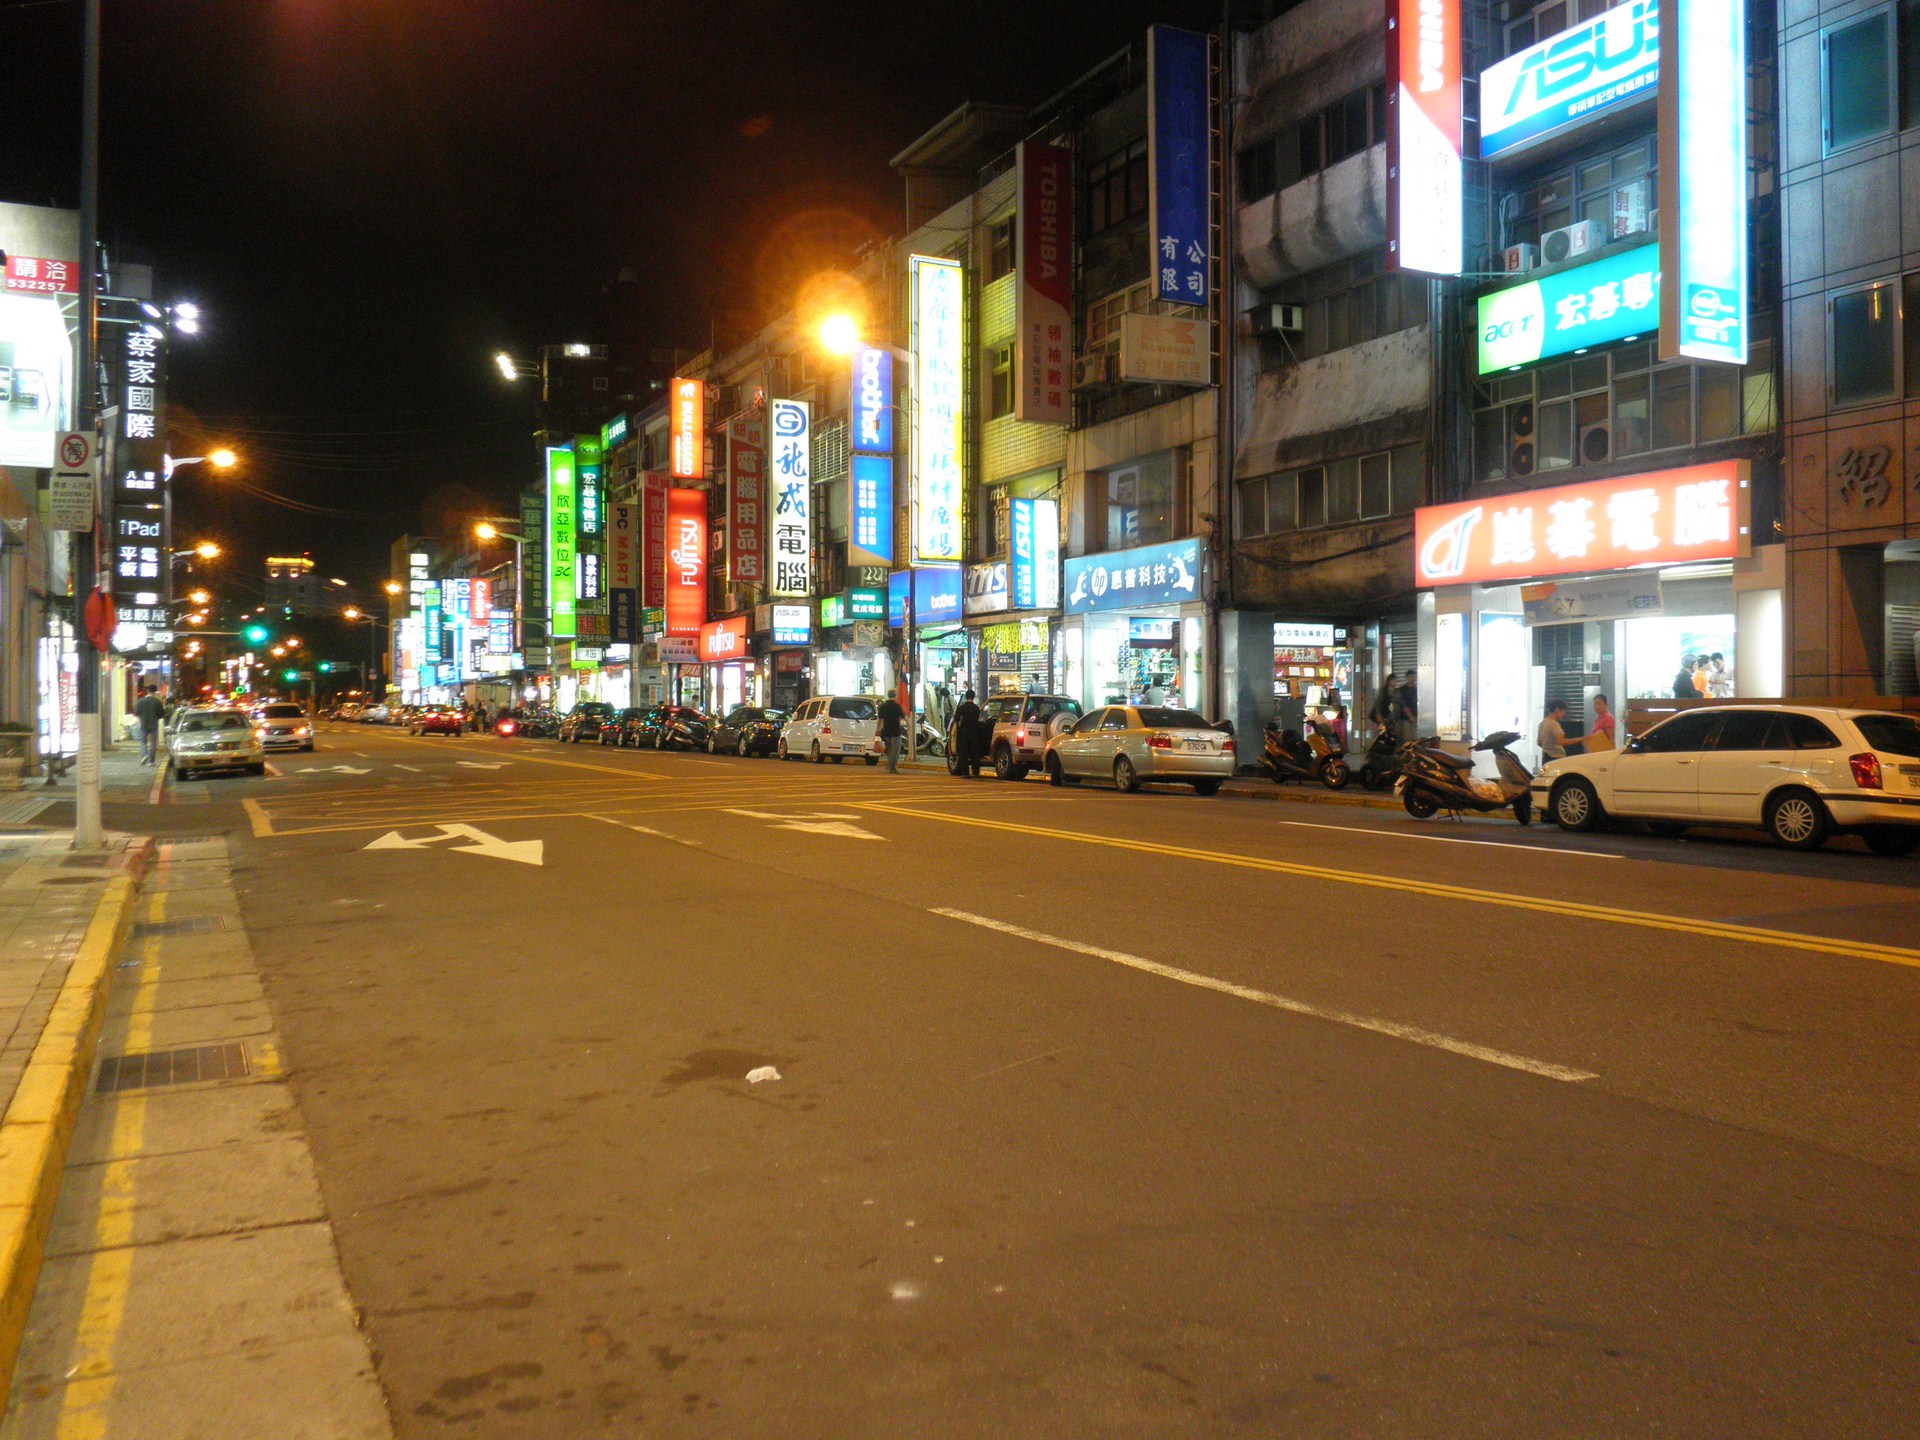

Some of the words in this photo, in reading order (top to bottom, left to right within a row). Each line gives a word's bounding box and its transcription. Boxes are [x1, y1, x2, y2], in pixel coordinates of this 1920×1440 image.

[1567, 69, 1658, 116] 華碩筆記型電腦展售
[1041, 166, 1058, 280] TOSHIBA
[1484, 313, 1535, 343] acer
[1555, 271, 1661, 331] 宏碁專
[126, 332, 156, 439] 蔡家國際
[556, 494, 570, 562] 欣亞數位
[616, 507, 629, 530] PC
[736, 450, 757, 577] 電腦用品店
[1015, 500, 1032, 561] msi
[616, 535, 629, 586] MART
[671, 519, 702, 586] FUJITSU
[708, 622, 735, 657] FUJITSU
[775, 609, 801, 617] ASUS
